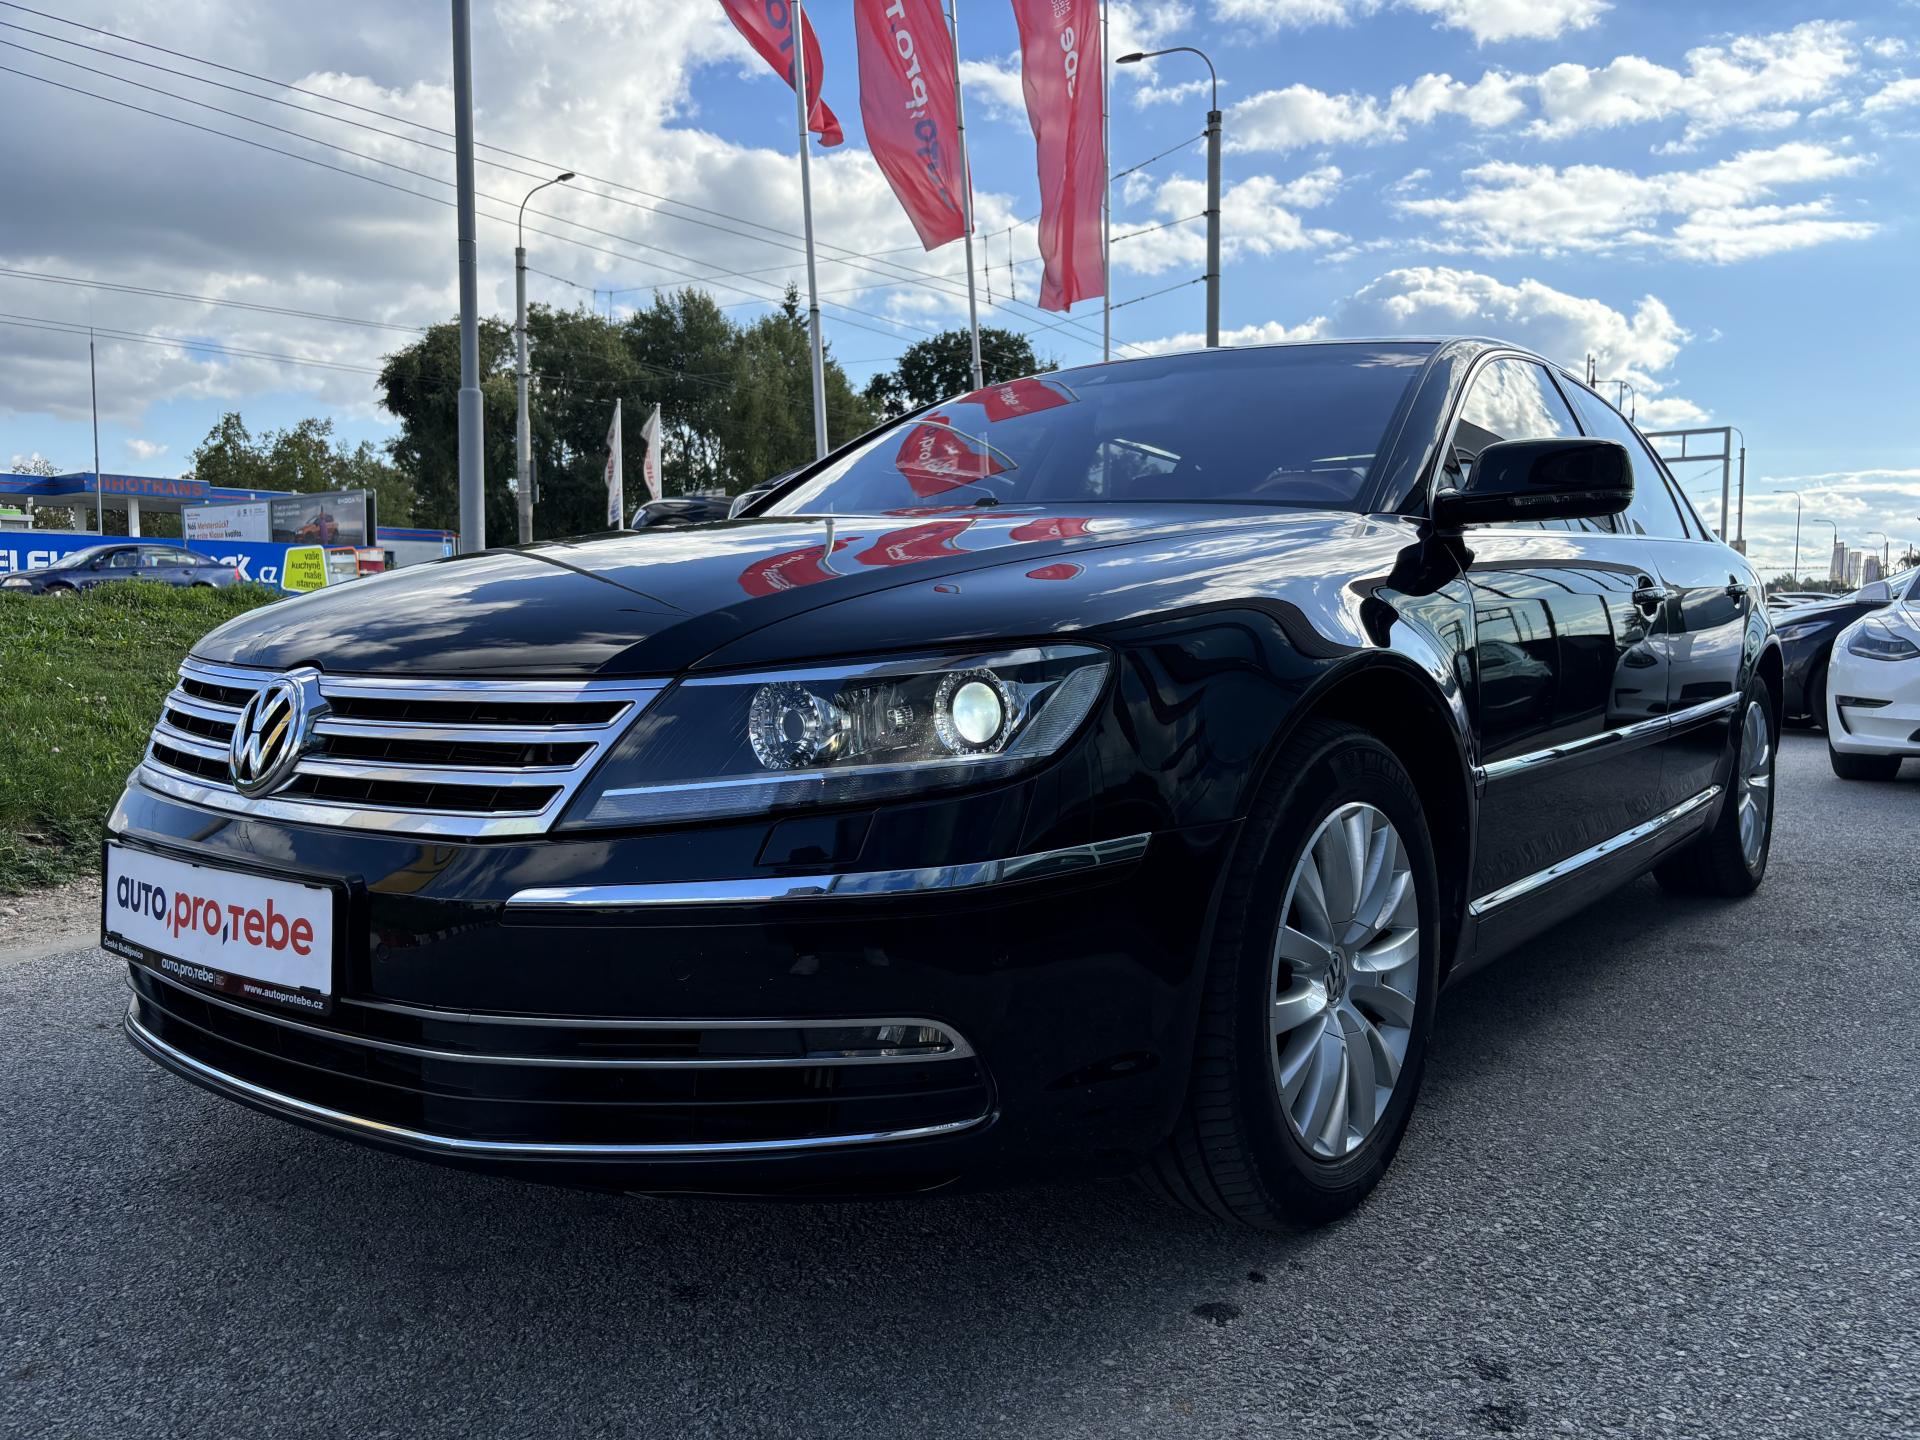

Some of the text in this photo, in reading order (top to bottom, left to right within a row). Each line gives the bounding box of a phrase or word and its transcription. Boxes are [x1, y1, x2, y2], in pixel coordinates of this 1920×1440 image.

[304, 551, 320, 560] vaše
[291, 561, 321, 571] kuchyně
[304, 571, 322, 580] naše
[243, 983, 324, 1010] www.autoprotebe.cz
